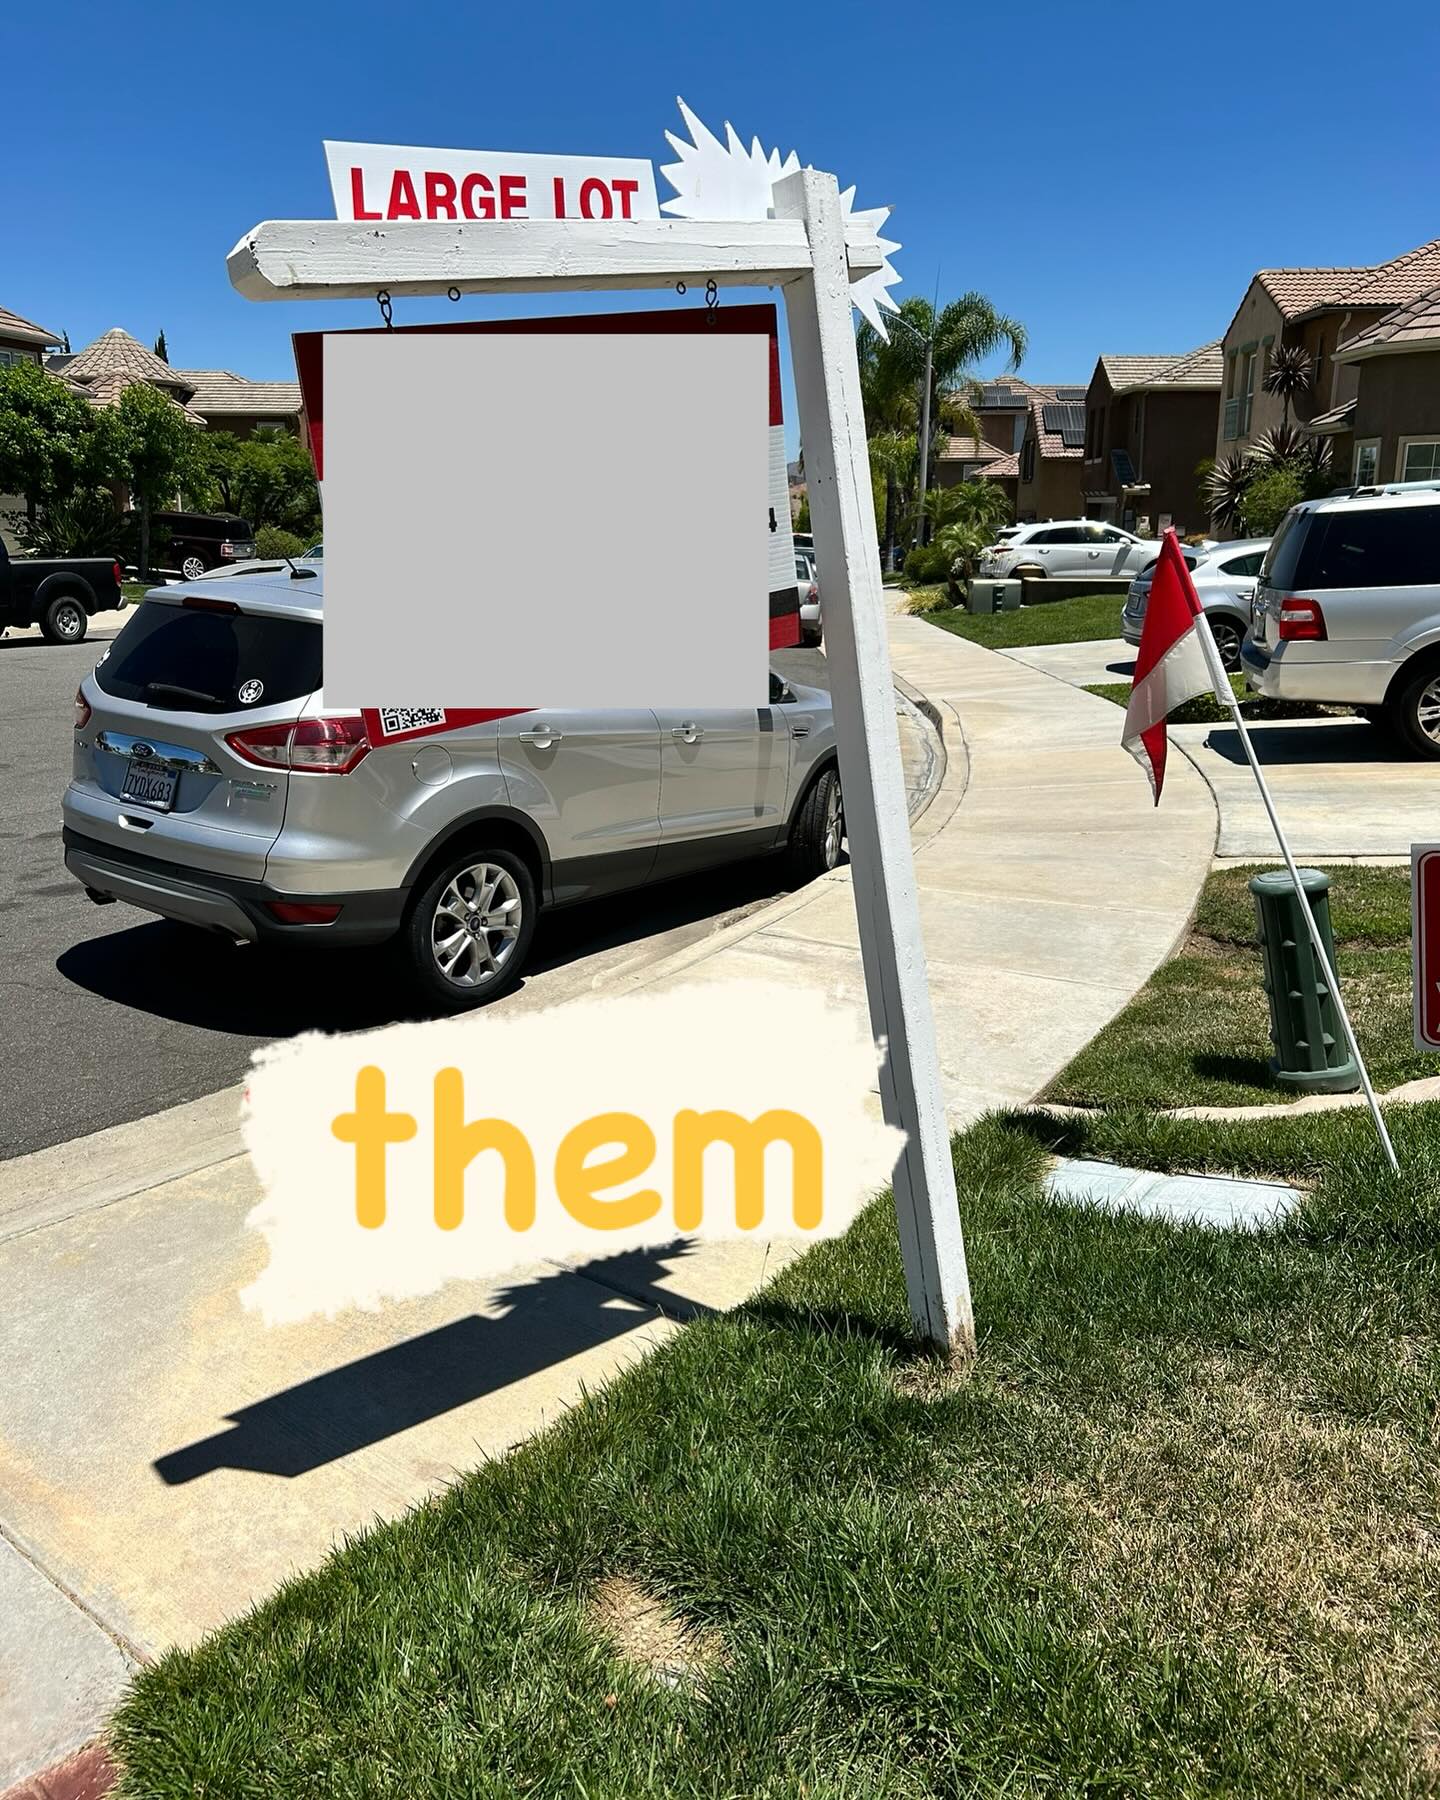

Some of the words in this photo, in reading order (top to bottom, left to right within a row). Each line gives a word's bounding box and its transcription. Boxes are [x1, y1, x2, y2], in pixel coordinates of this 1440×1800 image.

[350, 166, 528, 221] LARGE
[553, 177, 639, 220] LOT
[128, 774, 172, 802] 7YDX683
